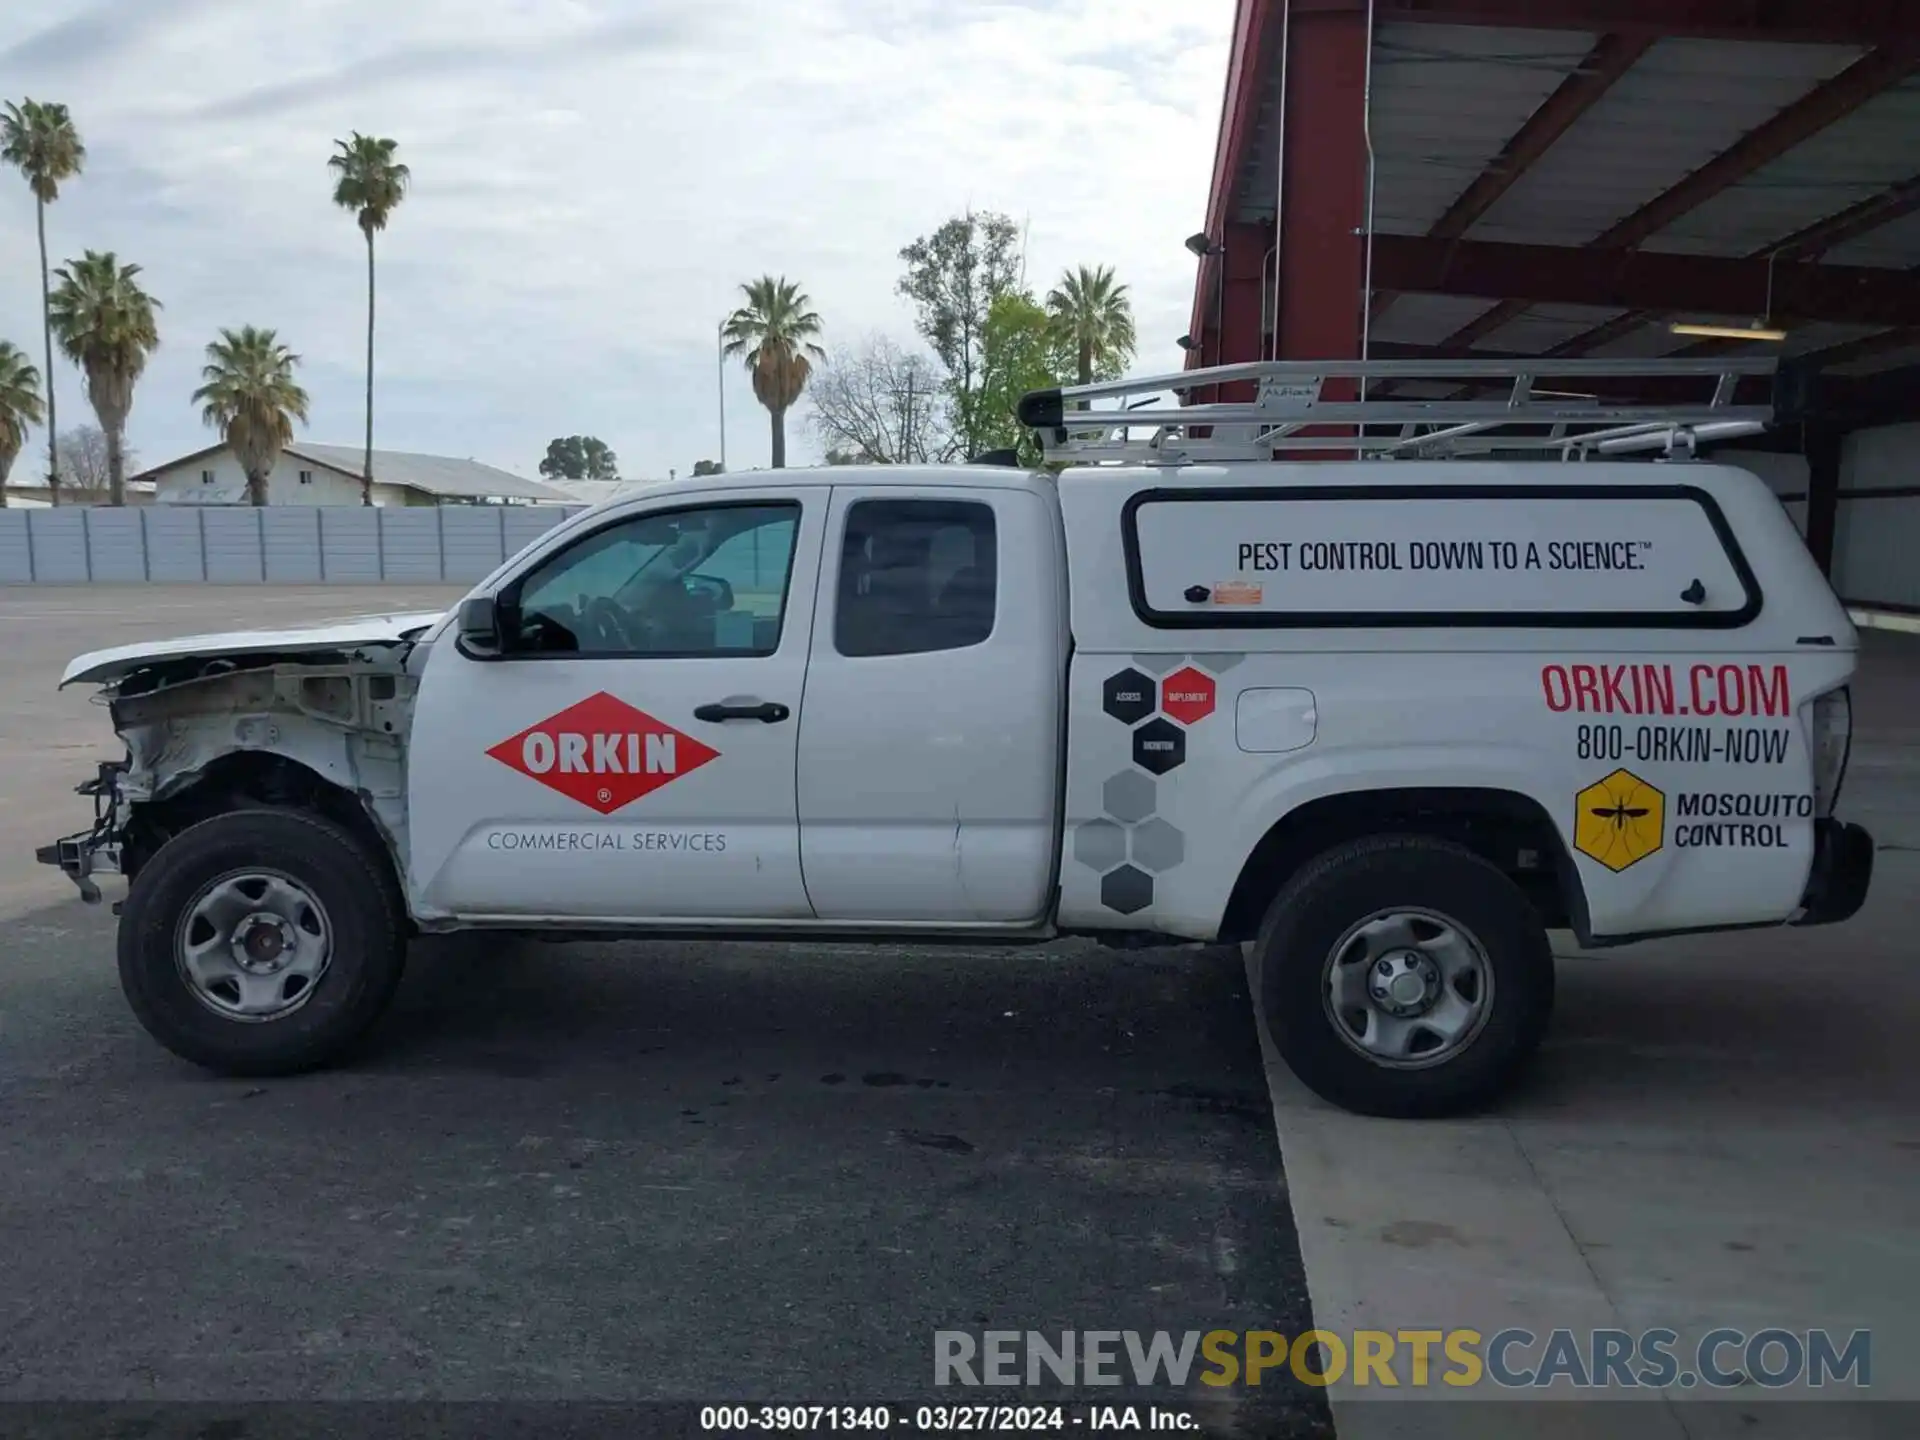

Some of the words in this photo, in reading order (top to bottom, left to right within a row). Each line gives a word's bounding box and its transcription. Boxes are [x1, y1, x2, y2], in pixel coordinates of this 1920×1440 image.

[1238, 543, 1293, 571] PEST
[1300, 542, 1402, 570] CONTROL
[1409, 542, 1483, 570] DOWN
[1489, 541, 1518, 570] TO
[1525, 542, 1541, 570] A
[1541, 664, 1790, 717] ORKIN.COM
[522, 731, 677, 775] ORKIN
[1576, 724, 1790, 764] 800-ORKIN-NOW
[1676, 793, 1814, 818] MOSQUITO
[487, 832, 625, 850] COMMERCIAL
[632, 833, 727, 851] SERVICES
[1674, 823, 1790, 848] CONTROL
